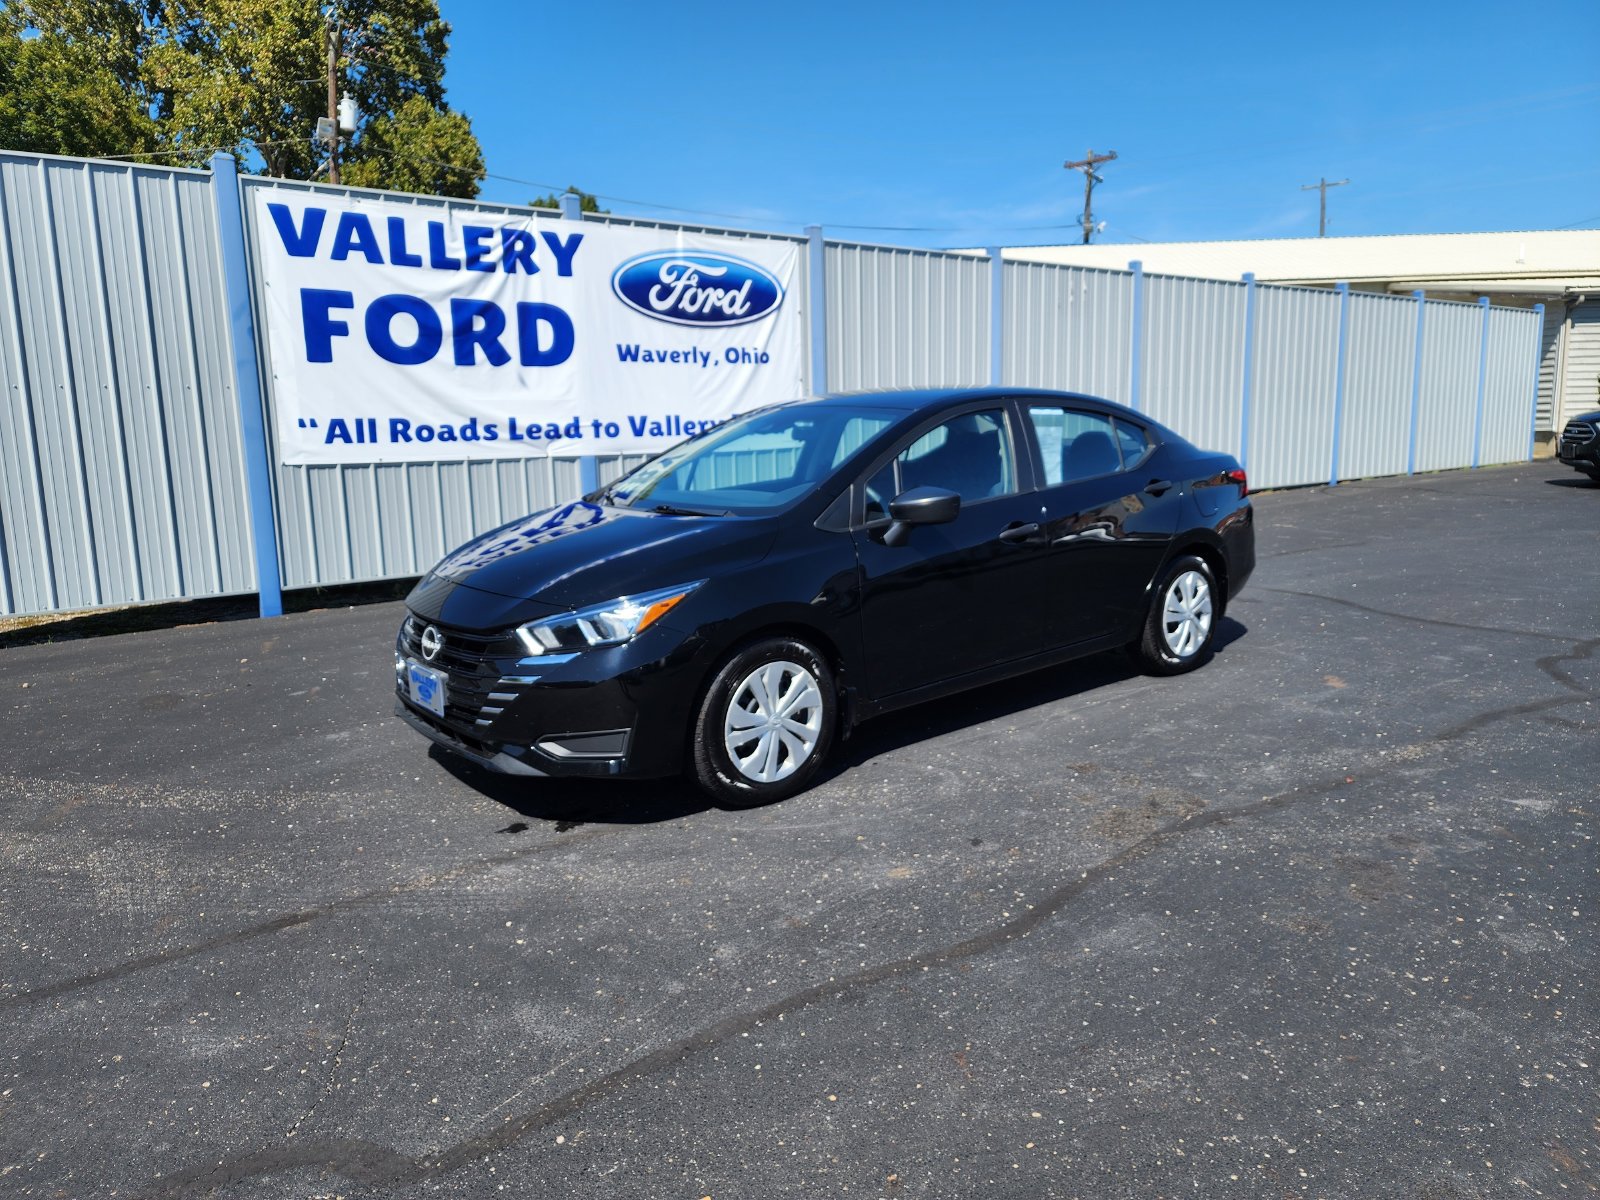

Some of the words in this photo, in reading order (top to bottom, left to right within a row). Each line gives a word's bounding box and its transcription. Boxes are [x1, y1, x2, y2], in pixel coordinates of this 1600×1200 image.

[267, 203, 584, 277] VALLERY
[648, 259, 753, 316] Ford
[299, 288, 575, 367] FORD
[616, 343, 719, 368] Waverly,
[724, 347, 770, 364] Ohio
[388, 417, 499, 443] Roads
[508, 416, 582, 441] Lead
[592, 418, 620, 439] to
